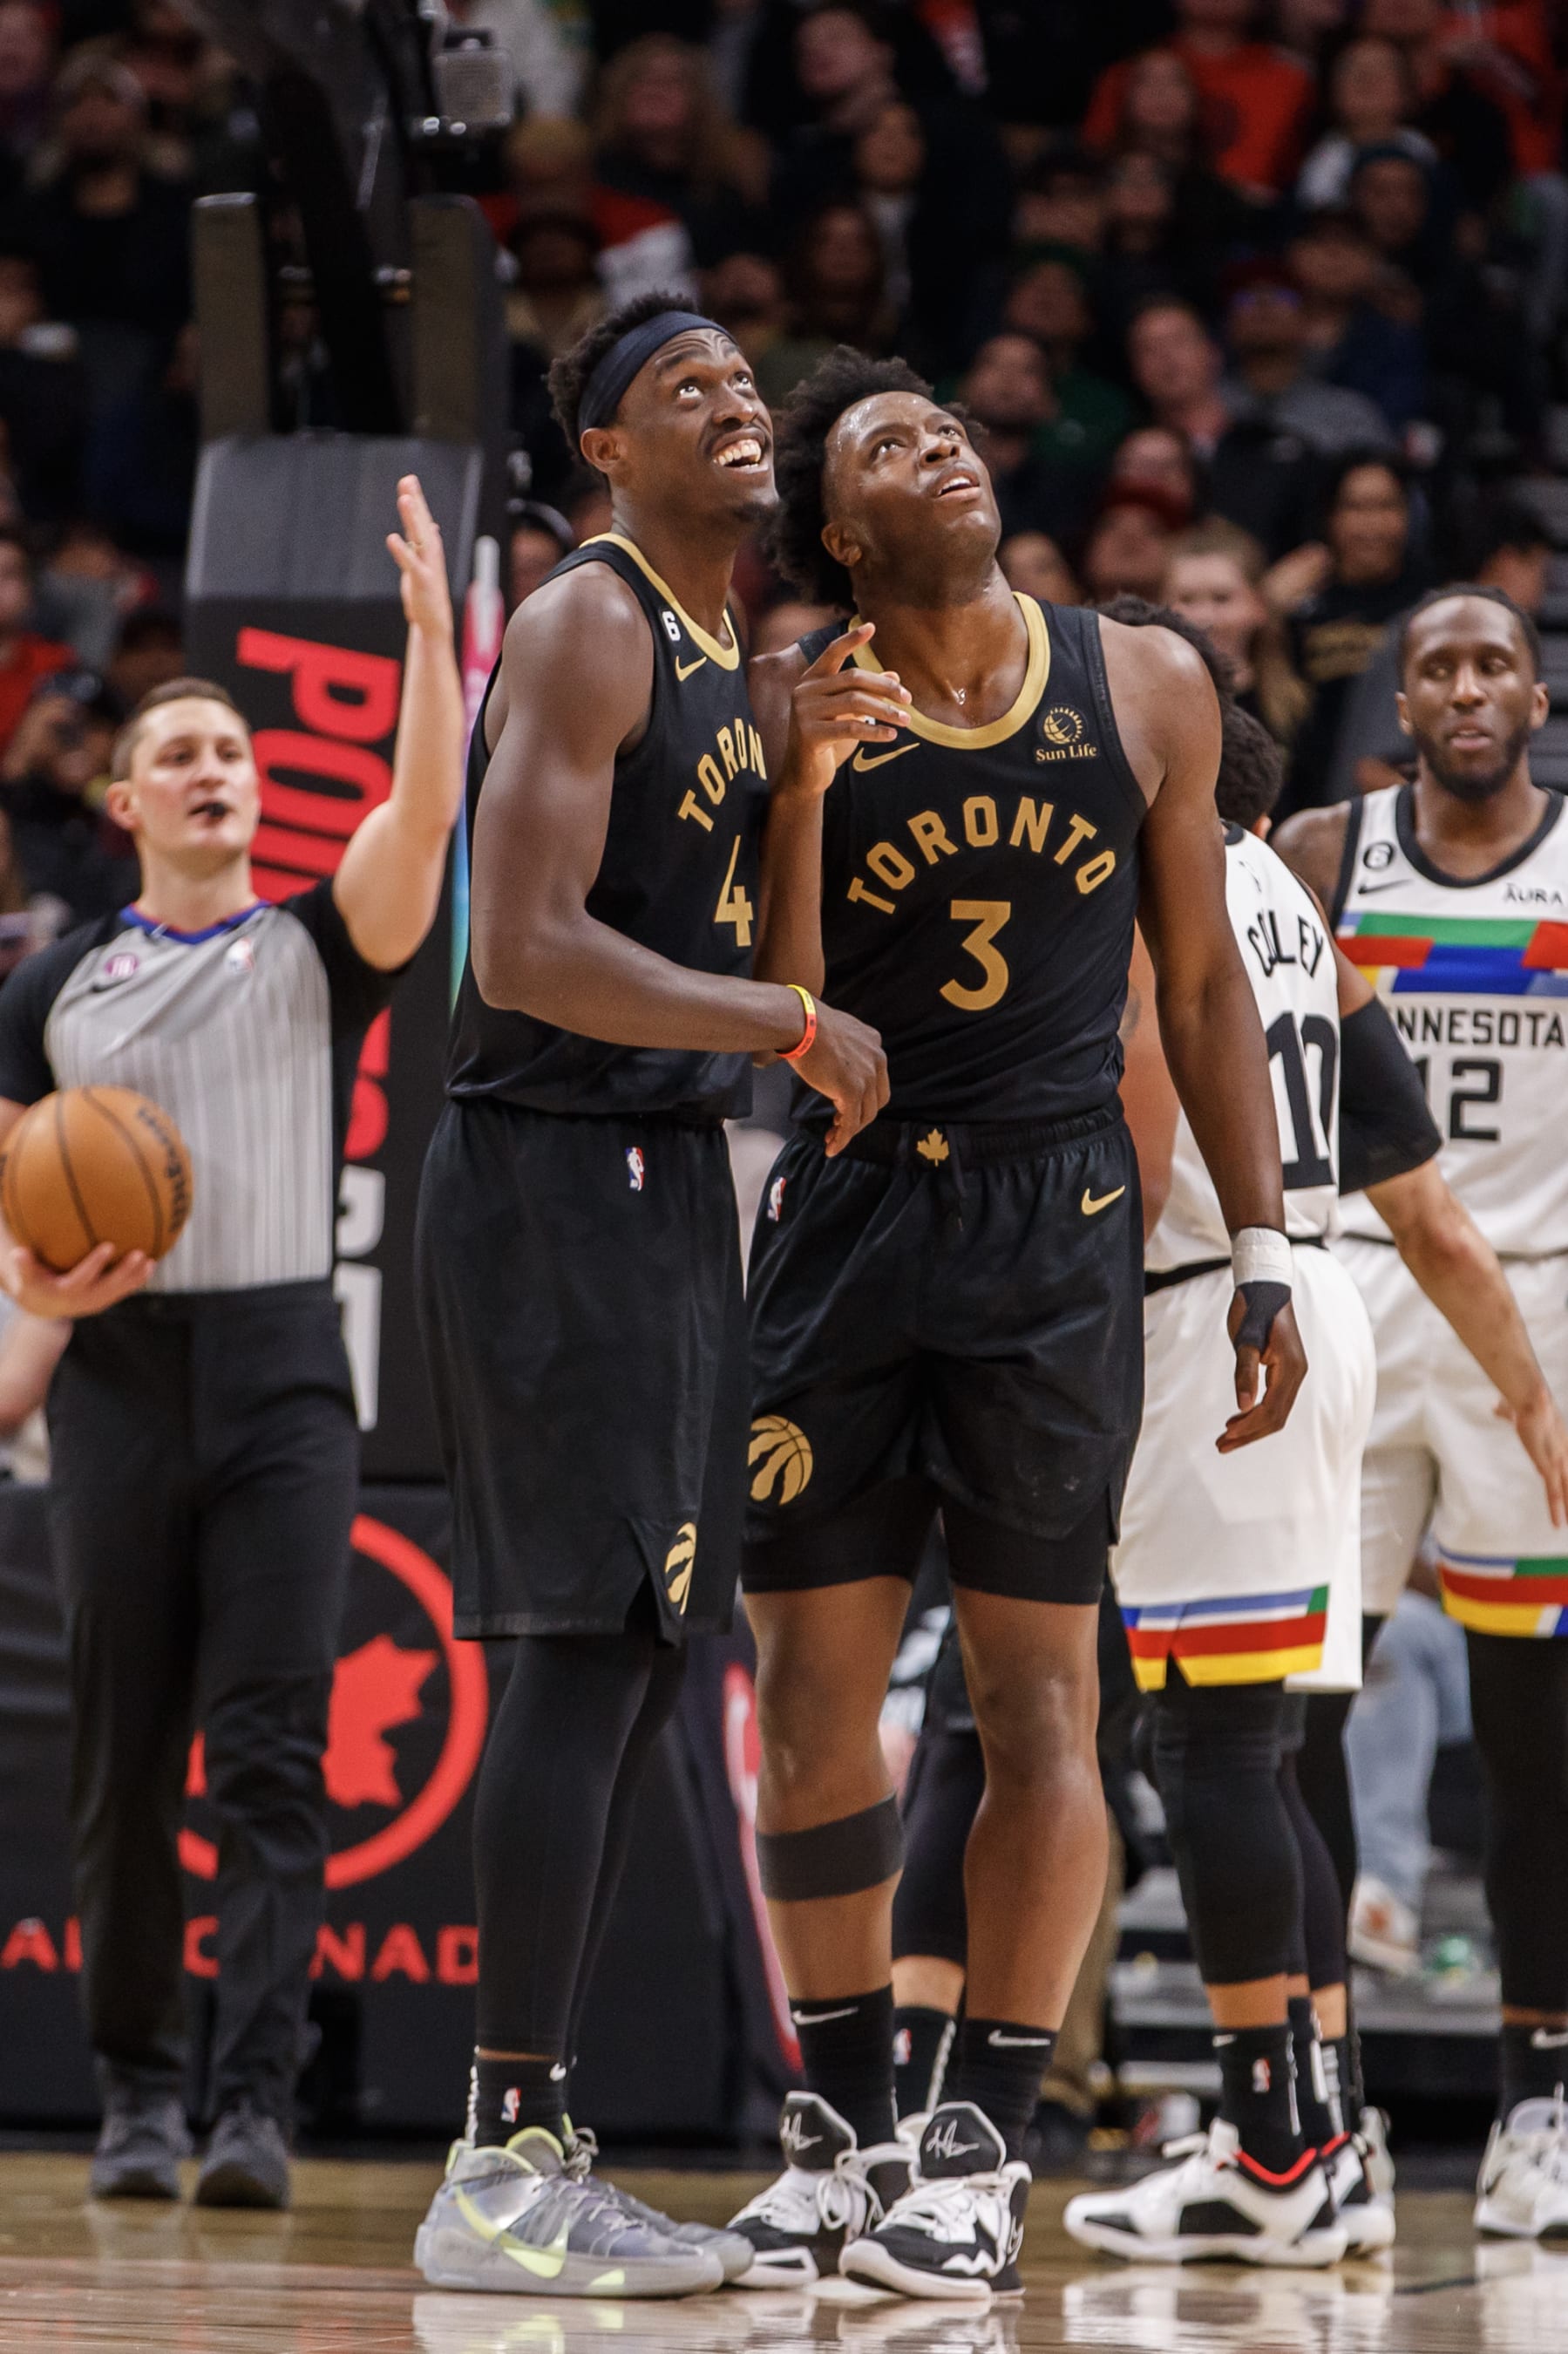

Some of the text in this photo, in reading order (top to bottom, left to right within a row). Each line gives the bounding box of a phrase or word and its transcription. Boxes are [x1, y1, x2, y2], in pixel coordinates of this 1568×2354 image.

[662, 610, 682, 642] 6
[676, 718, 768, 833] TORON
[1035, 743, 1098, 762] Sun Life
[714, 834, 754, 948] 4
[846, 794, 1117, 915] TORONTO
[939, 899, 1012, 1011] 3
[1397, 1007, 1566, 1049] NNESOTA
[0, 1915, 480, 1986] AI CNAD
